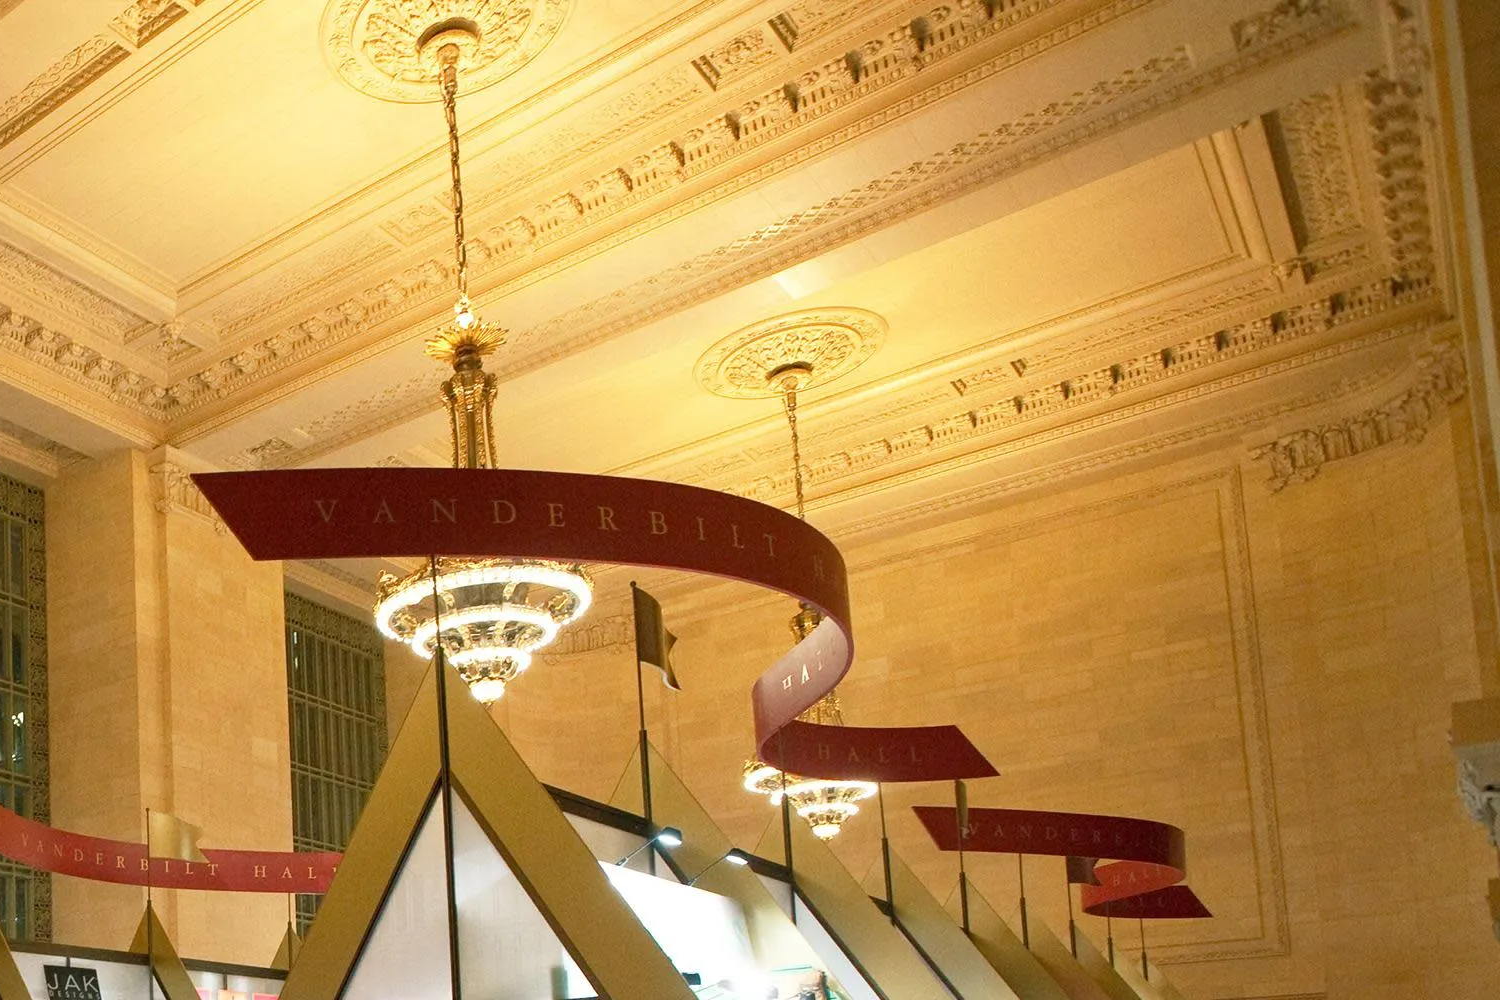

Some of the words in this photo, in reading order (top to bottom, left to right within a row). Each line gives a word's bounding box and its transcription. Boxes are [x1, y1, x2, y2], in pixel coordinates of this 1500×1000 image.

[315, 498, 779, 557] VANDERBILT
[818, 743, 922, 764] HALL
[21, 832, 219, 877] VANDERBILT
[254, 865, 338, 880] HAL
[47, 973, 99, 993] JAK
[48, 990, 102, 1000] DESIGNS
